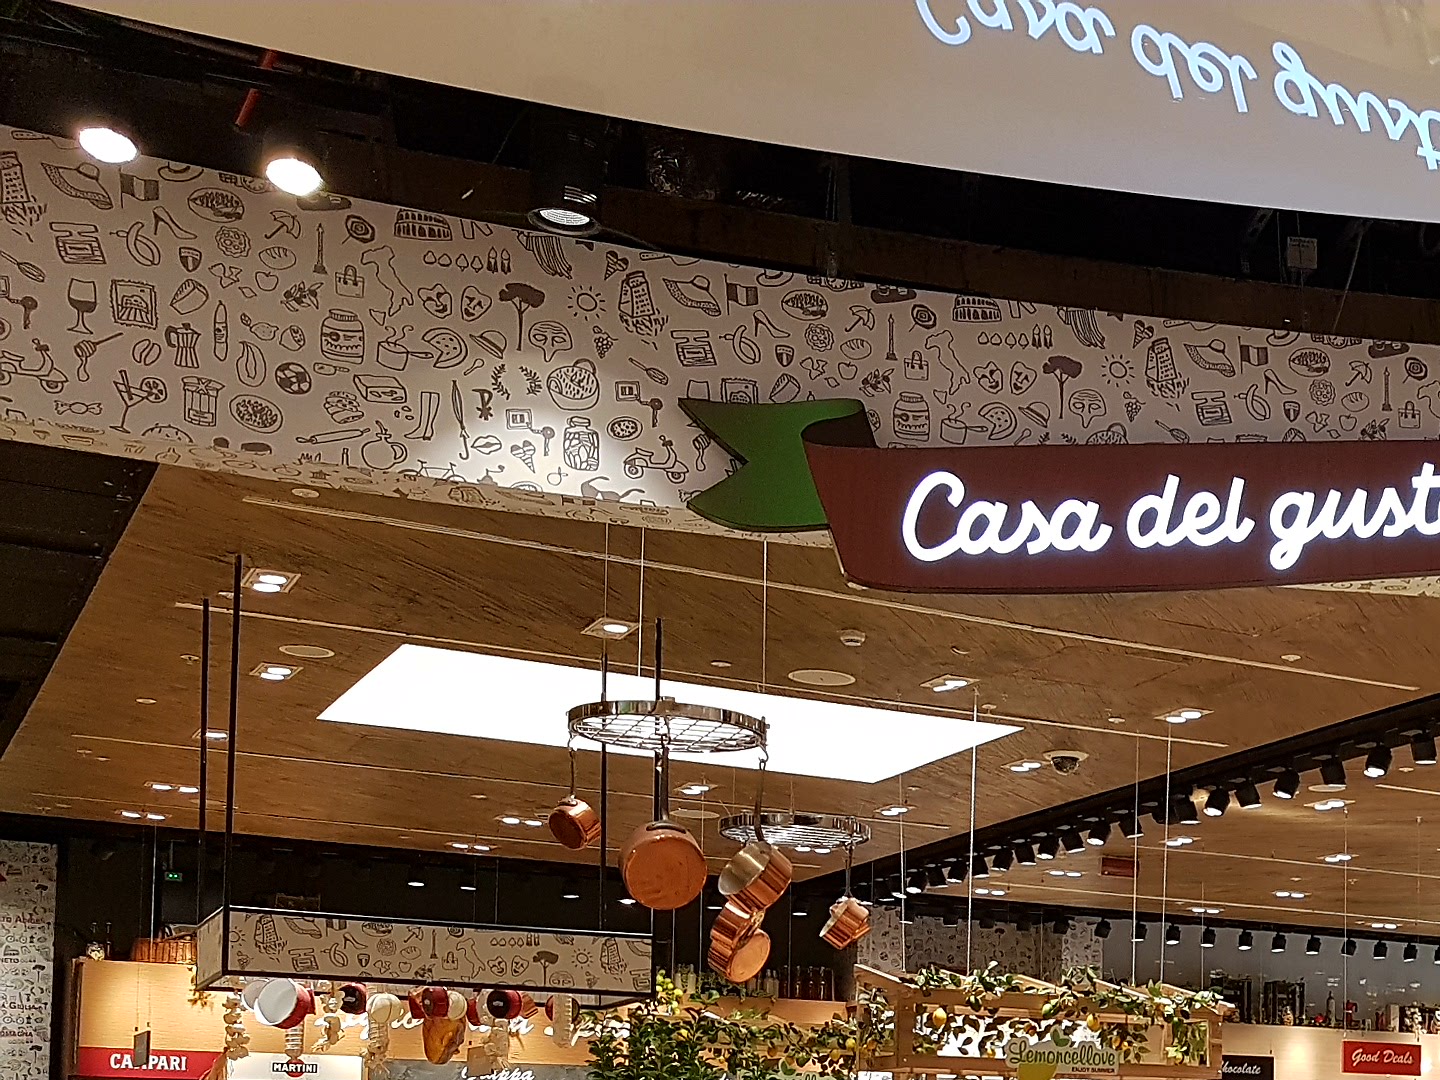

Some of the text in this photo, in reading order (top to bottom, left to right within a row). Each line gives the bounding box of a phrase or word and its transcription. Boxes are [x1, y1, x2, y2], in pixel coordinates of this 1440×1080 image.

[901, 469, 1113, 562] Casa
[1125, 474, 1255, 551] del
[1007, 1038, 1116, 1067] Lemoncellove
[1352, 1049, 1413, 1067] Good Deals
[110, 1053, 187, 1071] CAPARI
[273, 1063, 317, 1074] MARTINI
[1221, 1059, 1262, 1075] hocolate
